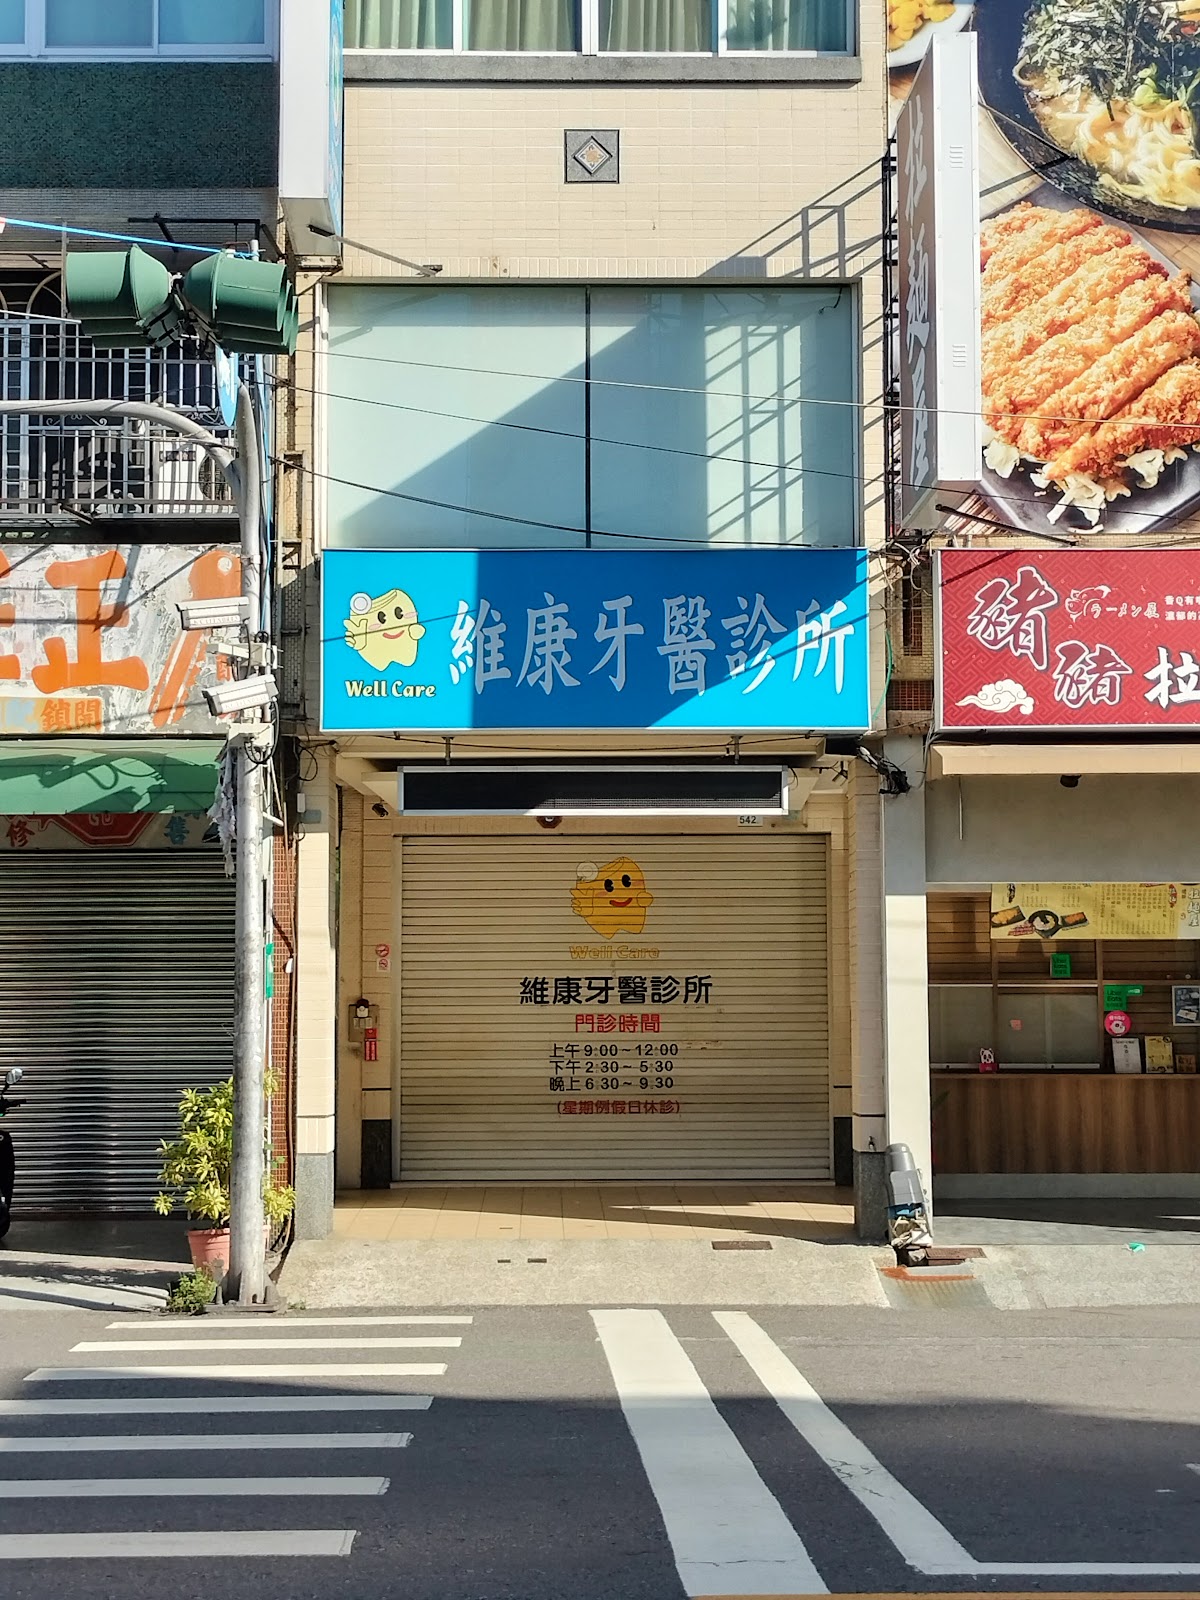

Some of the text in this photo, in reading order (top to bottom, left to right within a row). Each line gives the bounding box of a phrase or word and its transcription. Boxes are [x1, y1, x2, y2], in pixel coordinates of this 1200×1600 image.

[448, 592, 855, 697] 維康牙醫診所
[344, 680, 436, 698] Well Care
[739, 815, 757, 825] 542
[569, 945, 660, 960] Well Care
[519, 975, 713, 1005] 維康牙醫診所
[575, 1013, 661, 1034] 門診時間
